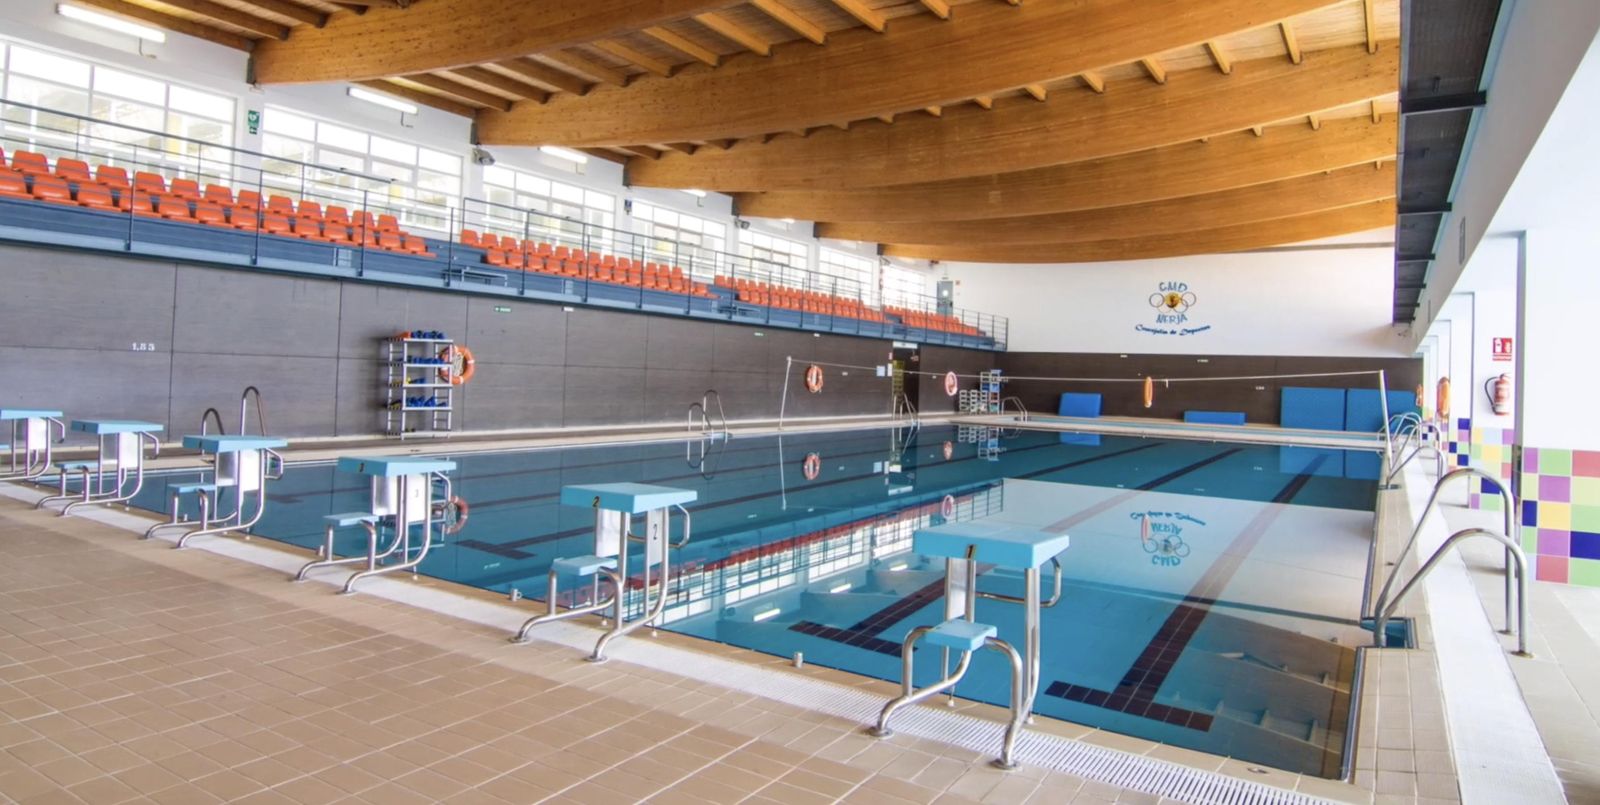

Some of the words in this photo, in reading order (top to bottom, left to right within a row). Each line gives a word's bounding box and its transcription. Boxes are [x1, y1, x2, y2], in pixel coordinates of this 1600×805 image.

[1159, 281, 1188, 292] CMD
[1156, 313, 1188, 325] NERJA
[592, 496, 600, 508] 2
[653, 523, 658, 540] 2
[967, 544, 975, 559] 1
